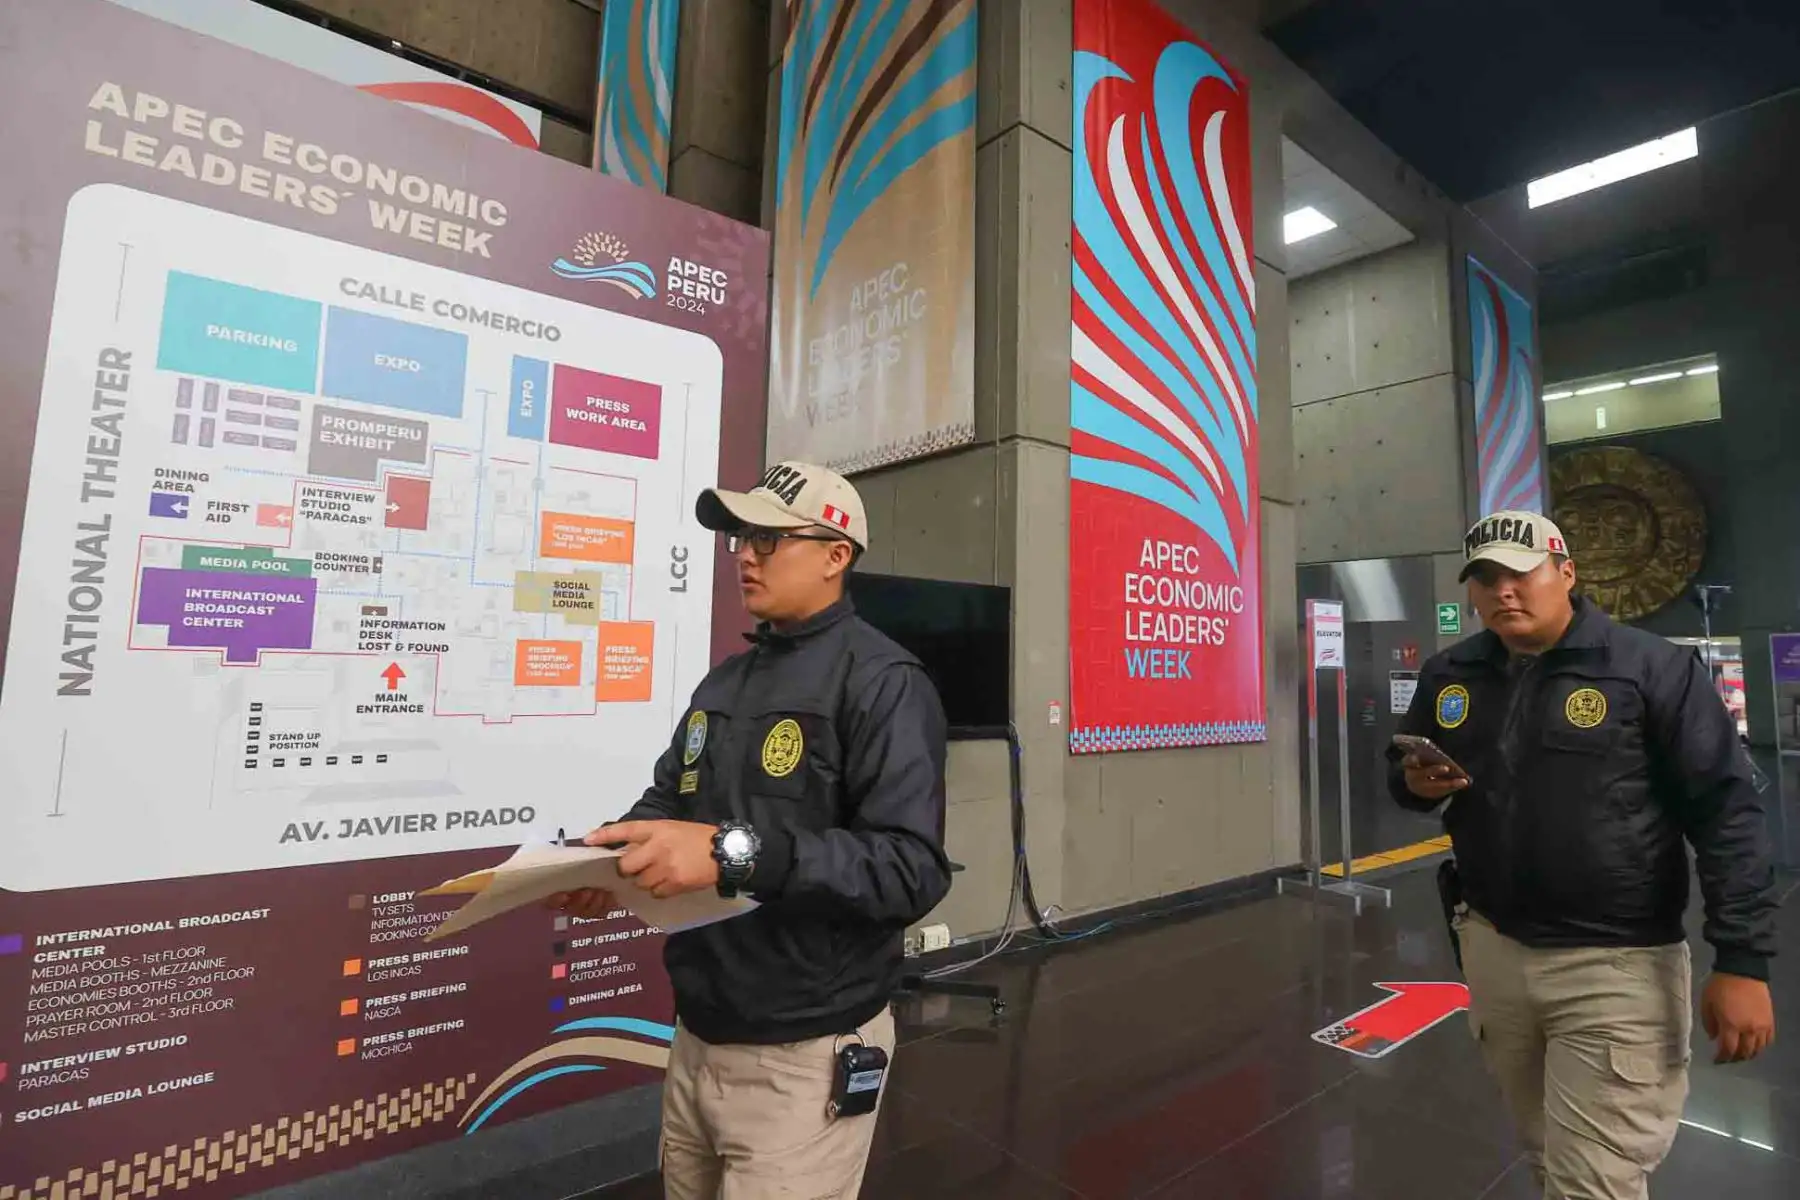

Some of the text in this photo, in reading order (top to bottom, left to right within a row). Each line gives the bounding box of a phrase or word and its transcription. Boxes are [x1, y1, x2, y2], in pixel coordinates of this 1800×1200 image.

[88, 81, 508, 226] APEC ECONOMIC
[369, 199, 494, 258] WEEK
[668, 256, 728, 287] APEC
[668, 274, 725, 305] PERU
[851, 262, 908, 313] APEC
[339, 276, 562, 342] CALLE COMERCIO
[667, 293, 705, 316] 2024
[809, 288, 927, 365] EONOMIC
[206, 324, 298, 352] PARKING
[373, 352, 421, 373] EXPO
[520, 379, 534, 417] EXPO
[586, 396, 631, 414] PRESS
[321, 415, 423, 442] PROMPERU
[566, 407, 648, 432] WORK AREA
[319, 431, 396, 453] EXHIBIT
[154, 467, 210, 483] DINING
[152, 480, 195, 493] AREA
[302, 487, 375, 504] INTERVIEW
[207, 500, 250, 513] FIRST
[301, 498, 351, 512] STUDIO
[57, 346, 132, 696] NATIONAL THEATER
[205, 512, 231, 524] AID
[200, 556, 290, 572] MEDIA POOL
[315, 551, 369, 563] BOOKING
[1140, 539, 1199, 574] APEC
[314, 562, 369, 574] COUNTER
[670, 545, 689, 593] LCC
[553, 580, 590, 591] SOCIAL
[553, 590, 585, 600] MEDIA
[1124, 572, 1244, 614] ECONOMIC
[185, 587, 305, 605] INTERNATIONAL
[552, 599, 594, 610] LOUNGE
[184, 602, 275, 616] BROADCAST
[183, 616, 244, 628] CENTER
[360, 619, 446, 631] INFORMATION
[1125, 610, 1229, 646] LEADERS'
[359, 630, 393, 640] DESK
[358, 642, 449, 653] LOST & FOUND
[1124, 648, 1192, 680] WEEK
[375, 693, 408, 703] MAIN
[356, 704, 424, 714] ENTRANCE
[269, 732, 321, 742] STAND UP
[269, 741, 319, 750] POSITION
[279, 806, 536, 844] AV. JAVIER PRADO
[373, 891, 415, 904] LOBBY
[372, 903, 414, 917] TV SETS
[36, 909, 271, 947] INTERNATIONAL BROADCAST
[371, 912, 440, 930] INFORMATION
[370, 928, 417, 943] BOOKING
[572, 937, 592, 948] SUP
[594, 931, 629, 945] (STAND
[632, 928, 645, 937] UP
[31, 963, 79, 980] MEDIA
[82, 955, 130, 973] POOLS
[142, 953, 161, 964] 1st
[163, 946, 207, 961] FLOOR
[34, 945, 106, 964] CENTER
[368, 946, 469, 969] PRESS BRIEFING
[571, 955, 619, 971] FIRST AID
[30, 979, 77, 996] MEDIA
[80, 969, 140, 989] BOOTHS
[151, 957, 227, 977] MEZZANINE
[367, 965, 422, 982] LOS INCAS
[570, 962, 636, 982] OUTDOOR PATIO
[27, 988, 117, 1011] ECONOMIES
[119, 978, 177, 997] BOOTHS
[187, 974, 211, 987] 2nd
[213, 966, 255, 982] FLOOR
[366, 982, 467, 1008] PRESS BRIEFING
[617, 983, 643, 996] AREA
[26, 1007, 84, 1028] PRAYER
[86, 1001, 131, 1017] ROOM
[142, 995, 168, 1008] 2nd
[170, 987, 213, 1003] FLOOR
[364, 1006, 401, 1021] NASCA
[24, 1023, 87, 1044] MASTER
[89, 1013, 157, 1033] CONTROL
[168, 1005, 190, 1019] 3rd
[192, 998, 234, 1014] FLOOR
[363, 1019, 464, 1047] PRESS BRIEFING
[20, 1035, 188, 1075] INTERVIEW STUDIO
[361, 1042, 413, 1061] MOCHICA
[18, 1067, 90, 1092] PARACAS
[14, 1072, 215, 1123] SOCIAL MEDIA LOUNGE
